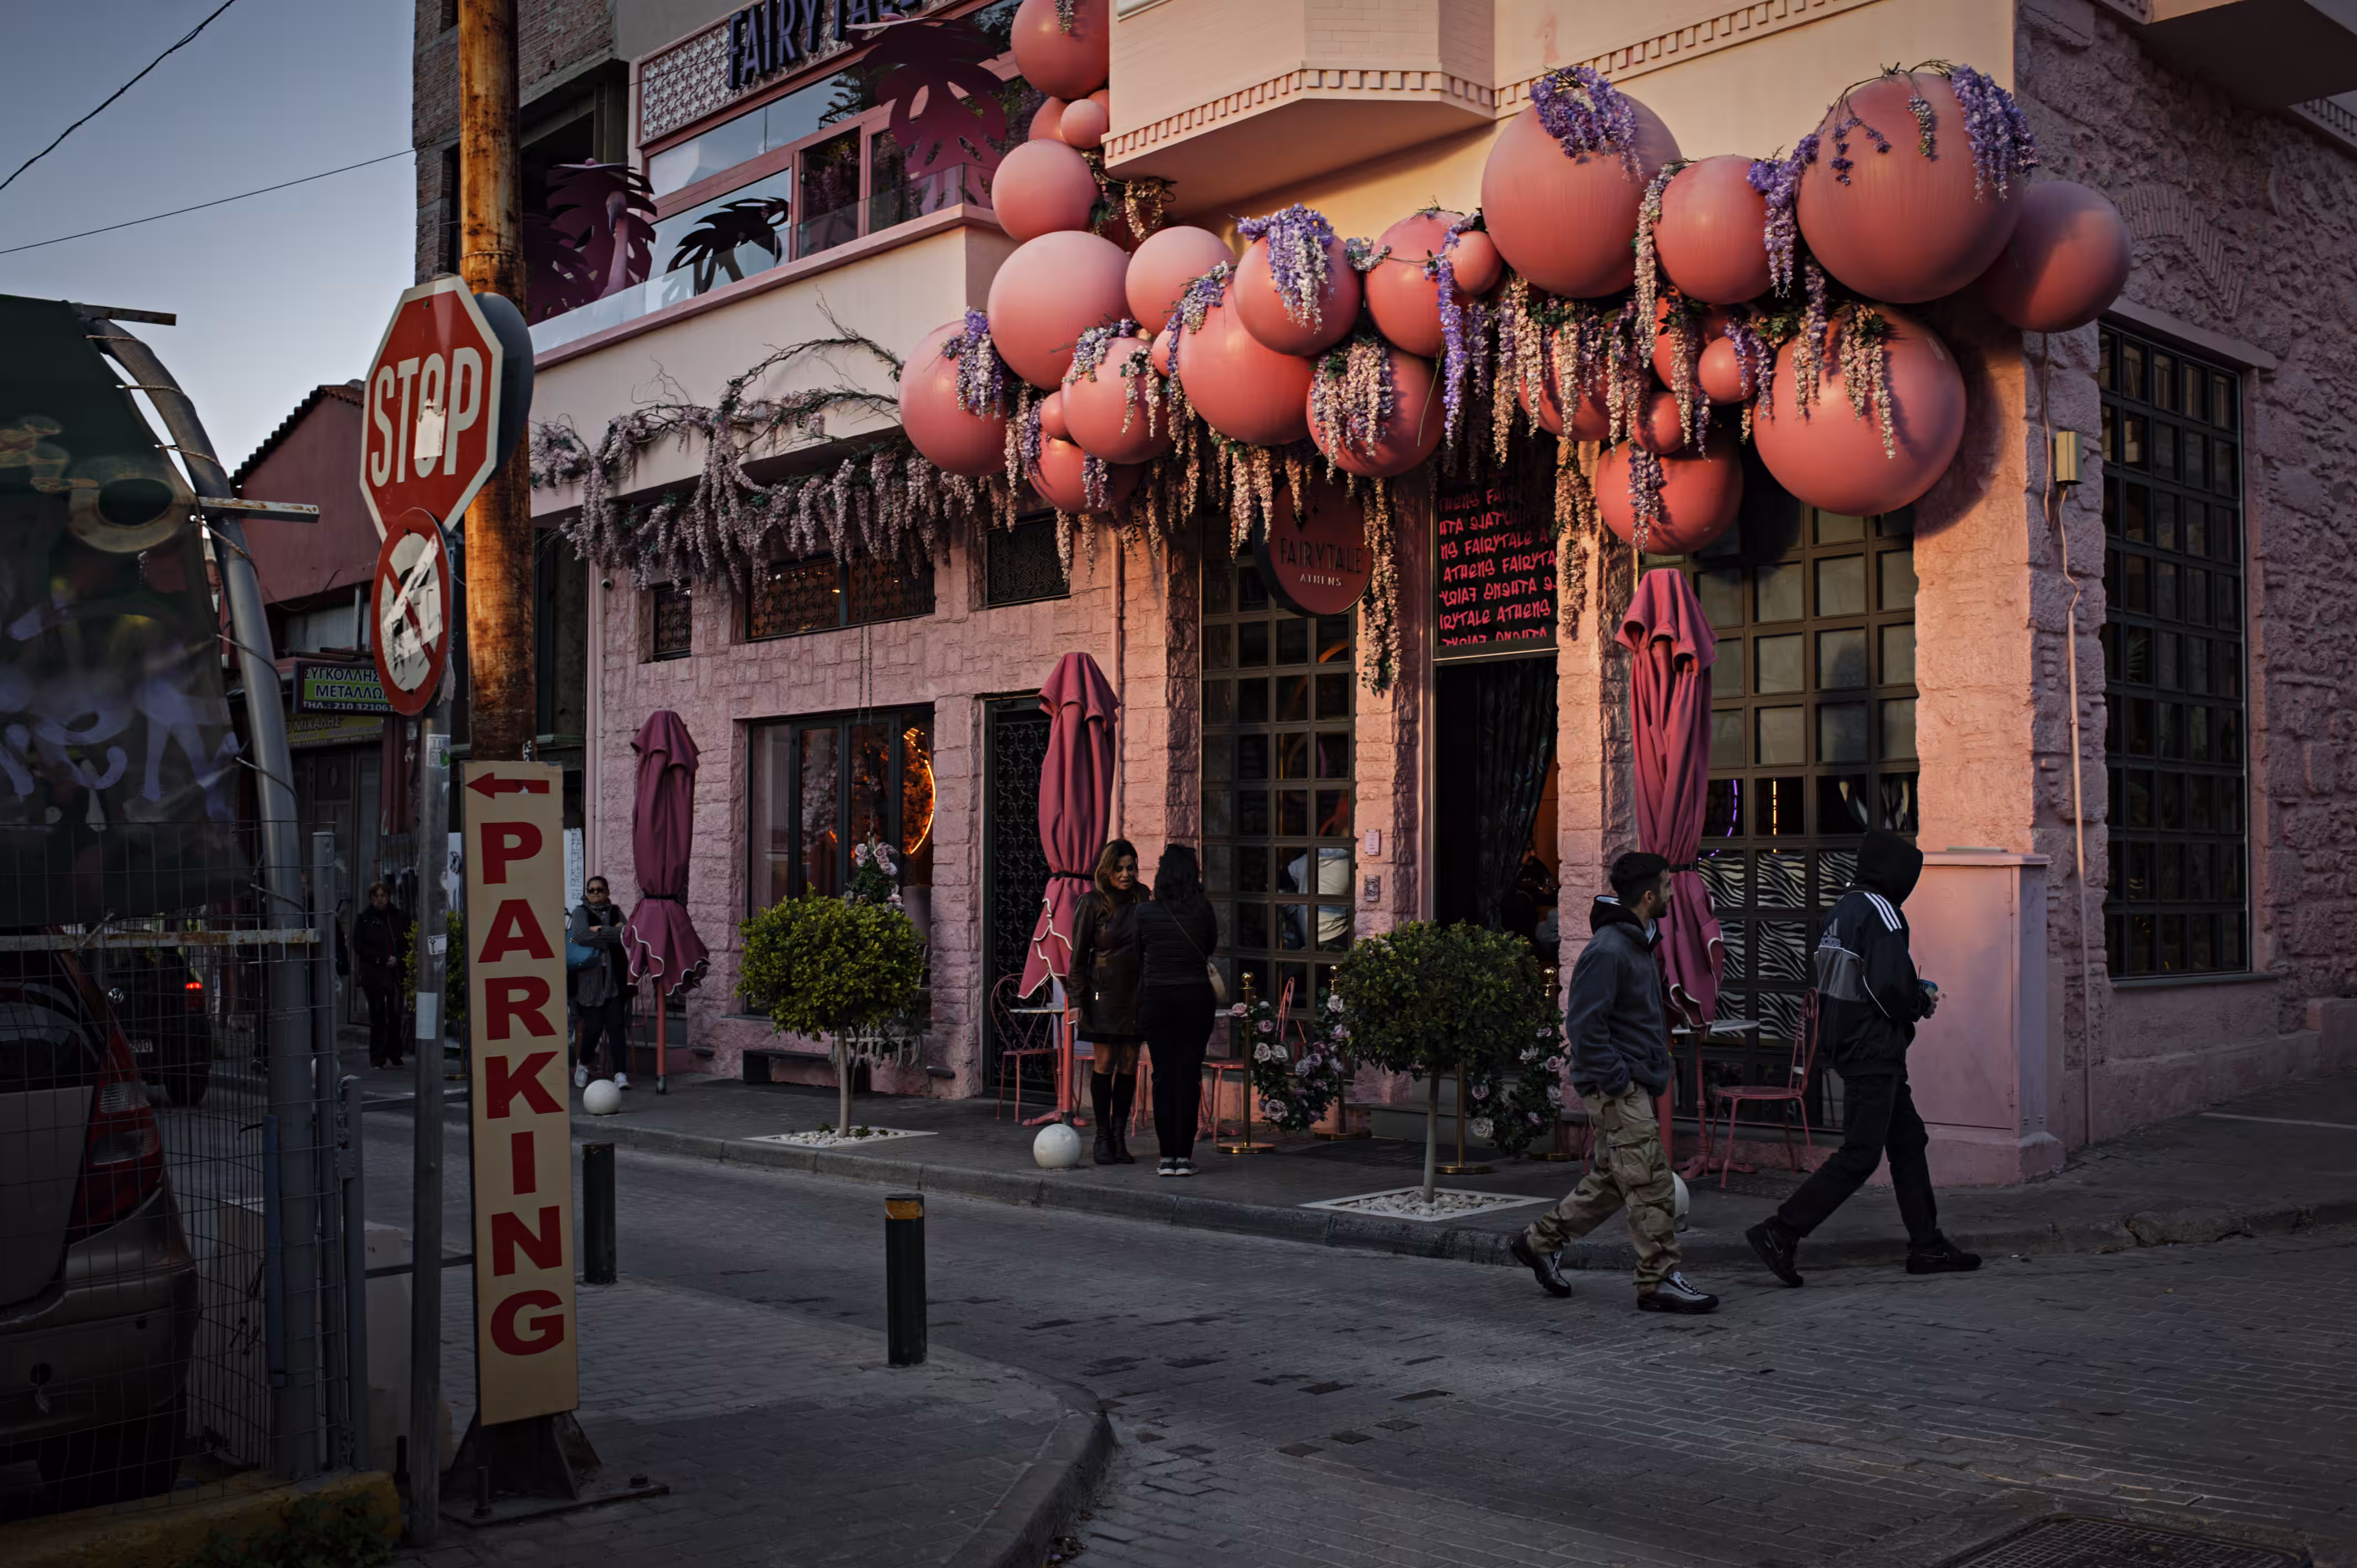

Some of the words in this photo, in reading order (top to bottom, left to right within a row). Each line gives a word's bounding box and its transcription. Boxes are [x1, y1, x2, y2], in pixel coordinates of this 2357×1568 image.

[728, 0, 917, 89] FAIRY
[371, 346, 483, 487] STOP
[1280, 538, 1362, 574] FAIRYTALE
[1299, 574, 1342, 586] ATHENS
[357, 703, 395, 711] 321061
[478, 822, 564, 1355] PARKING
